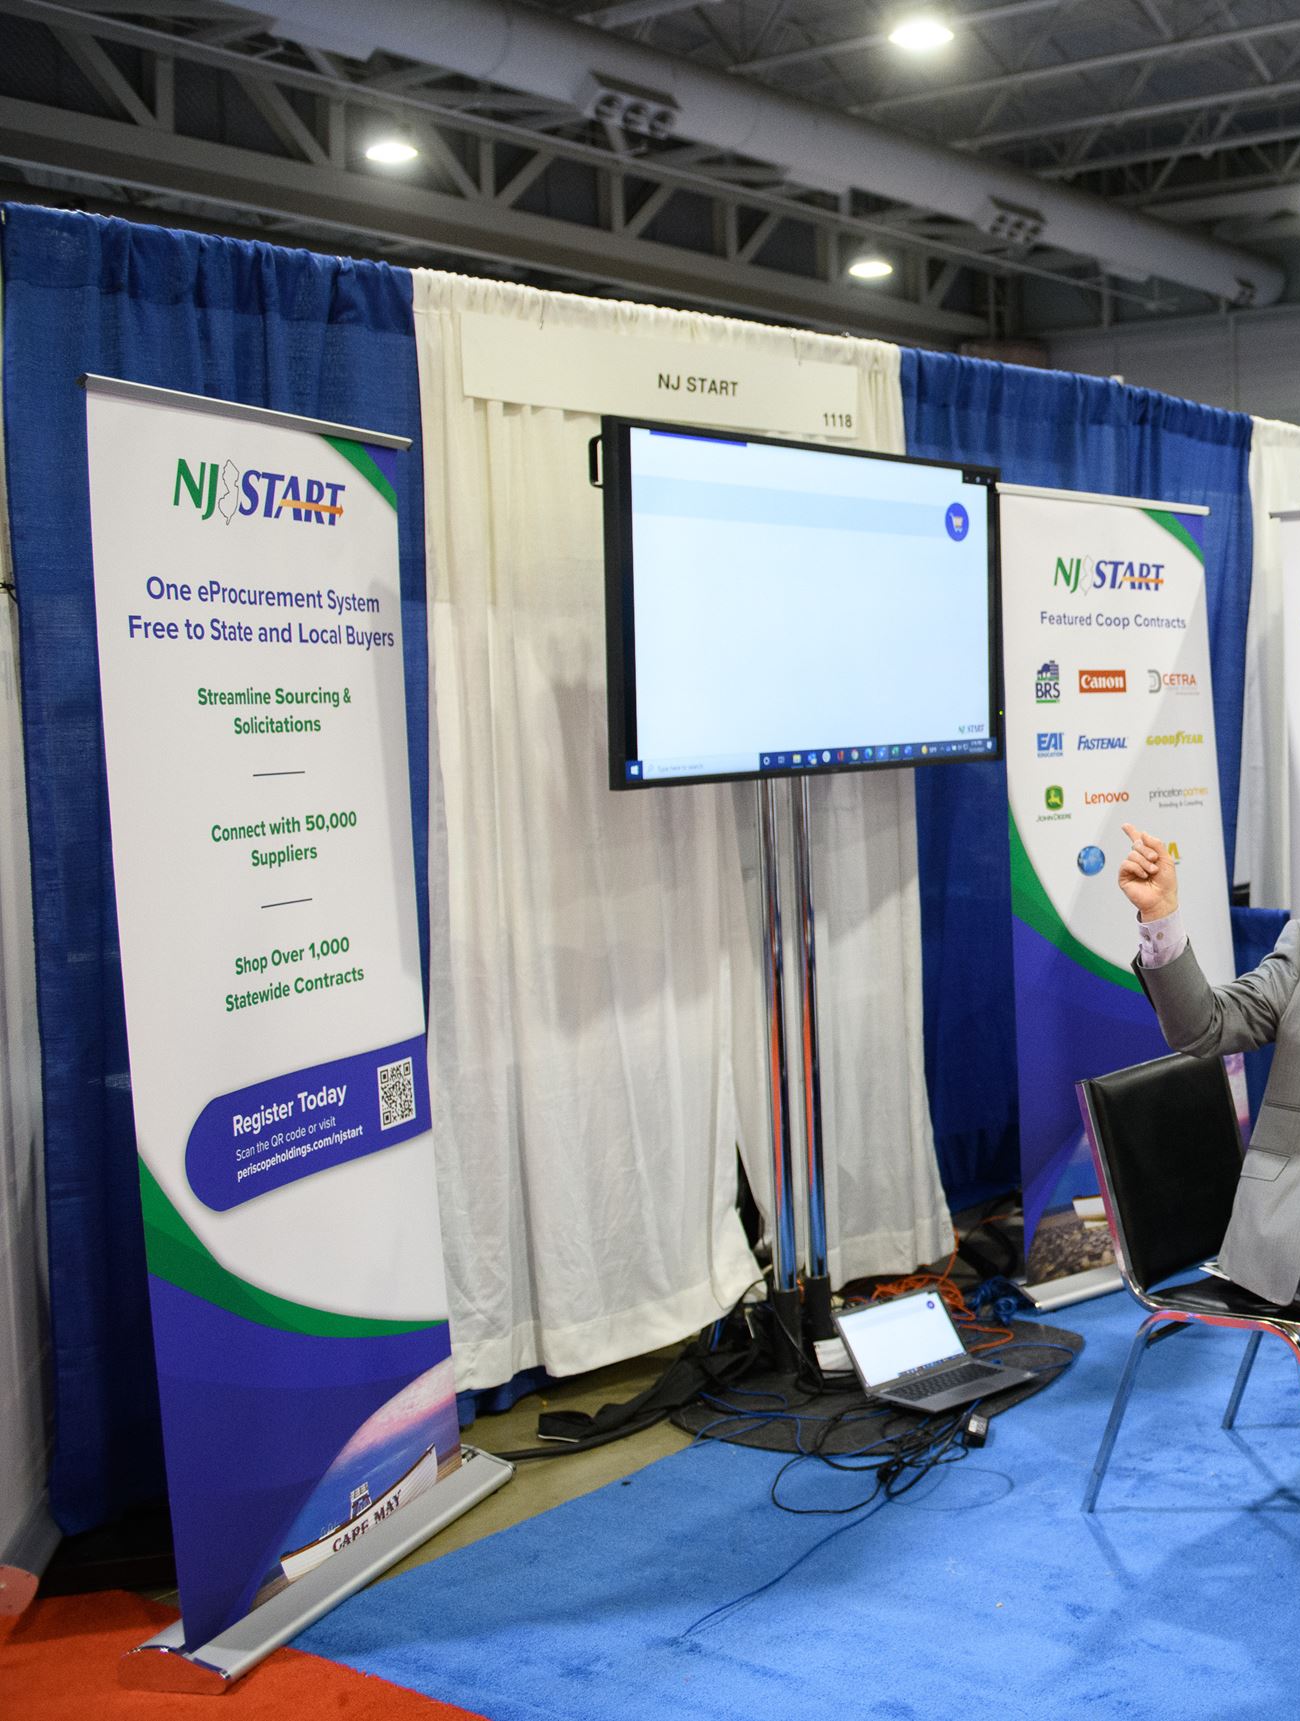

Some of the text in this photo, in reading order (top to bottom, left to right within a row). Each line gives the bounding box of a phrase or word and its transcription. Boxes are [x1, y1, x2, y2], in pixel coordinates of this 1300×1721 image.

[658, 373, 738, 397] NJ START
[823, 413, 852, 428] 1118
[173, 458, 346, 526] NJ START
[1053, 557, 1164, 593] NJ START
[146, 576, 380, 615] One eProcurement System
[1040, 611, 1186, 629] Featured Coop Contracts
[128, 615, 395, 650] Free to State and Local Buyers
[1035, 682, 1060, 699] BRS
[1080, 675, 1124, 689] Canon
[1163, 673, 1197, 686] CETRA
[197, 687, 351, 707] Streamline Sourcing &
[233, 715, 321, 735] Solicitations
[1037, 732, 1063, 750] EAI
[1077, 735, 1128, 750] FASTENAL
[1146, 730, 1203, 747] GOODYEAR
[1084, 790, 1129, 805] Lenovo
[211, 810, 357, 842] Connect with 50,000
[1036, 813, 1072, 823] JOHN DEERE
[251, 845, 318, 869] Suppliers
[235, 937, 350, 975] Shop Over 1,000
[225, 966, 364, 1012] Statewide Contracts
[232, 1085, 347, 1137] Register Today
[236, 1116, 336, 1161] Scan the QR code or visit
[237, 1125, 363, 1183] periscopeholdings.com/njstart
[333, 1489, 402, 1553] CAPE MAY
